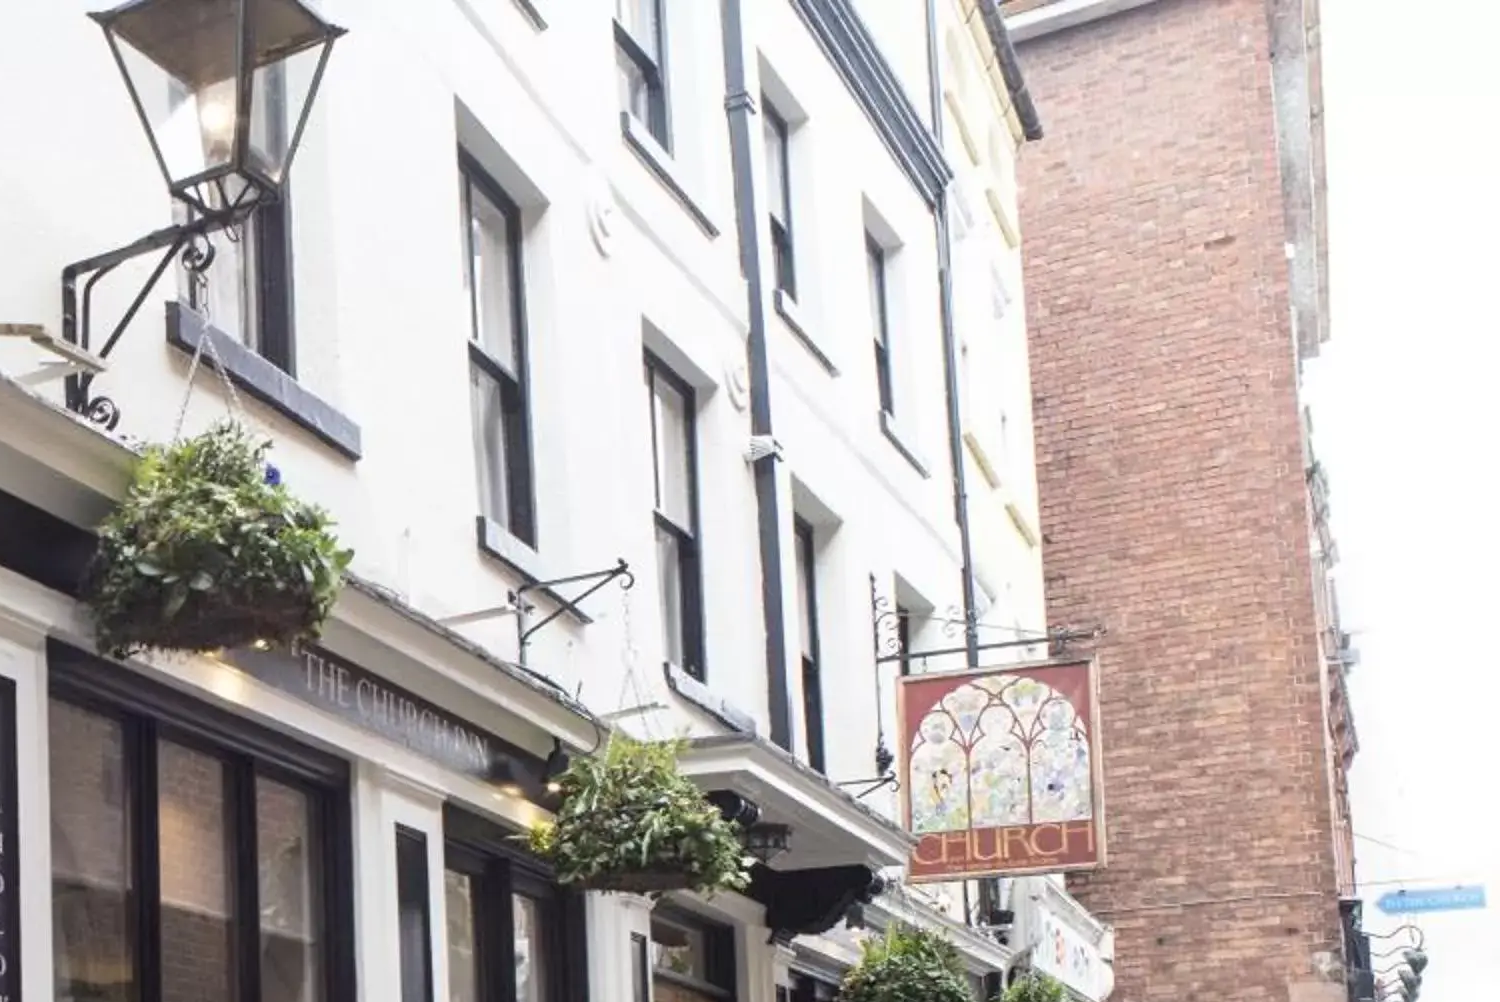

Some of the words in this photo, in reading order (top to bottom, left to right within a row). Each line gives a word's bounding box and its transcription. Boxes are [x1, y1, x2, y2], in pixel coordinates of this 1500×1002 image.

[302, 649, 351, 709] THE
[356, 677, 449, 746] CHURCH
[452, 724, 489, 772] INN
[912, 820, 1094, 866] CHURCH
